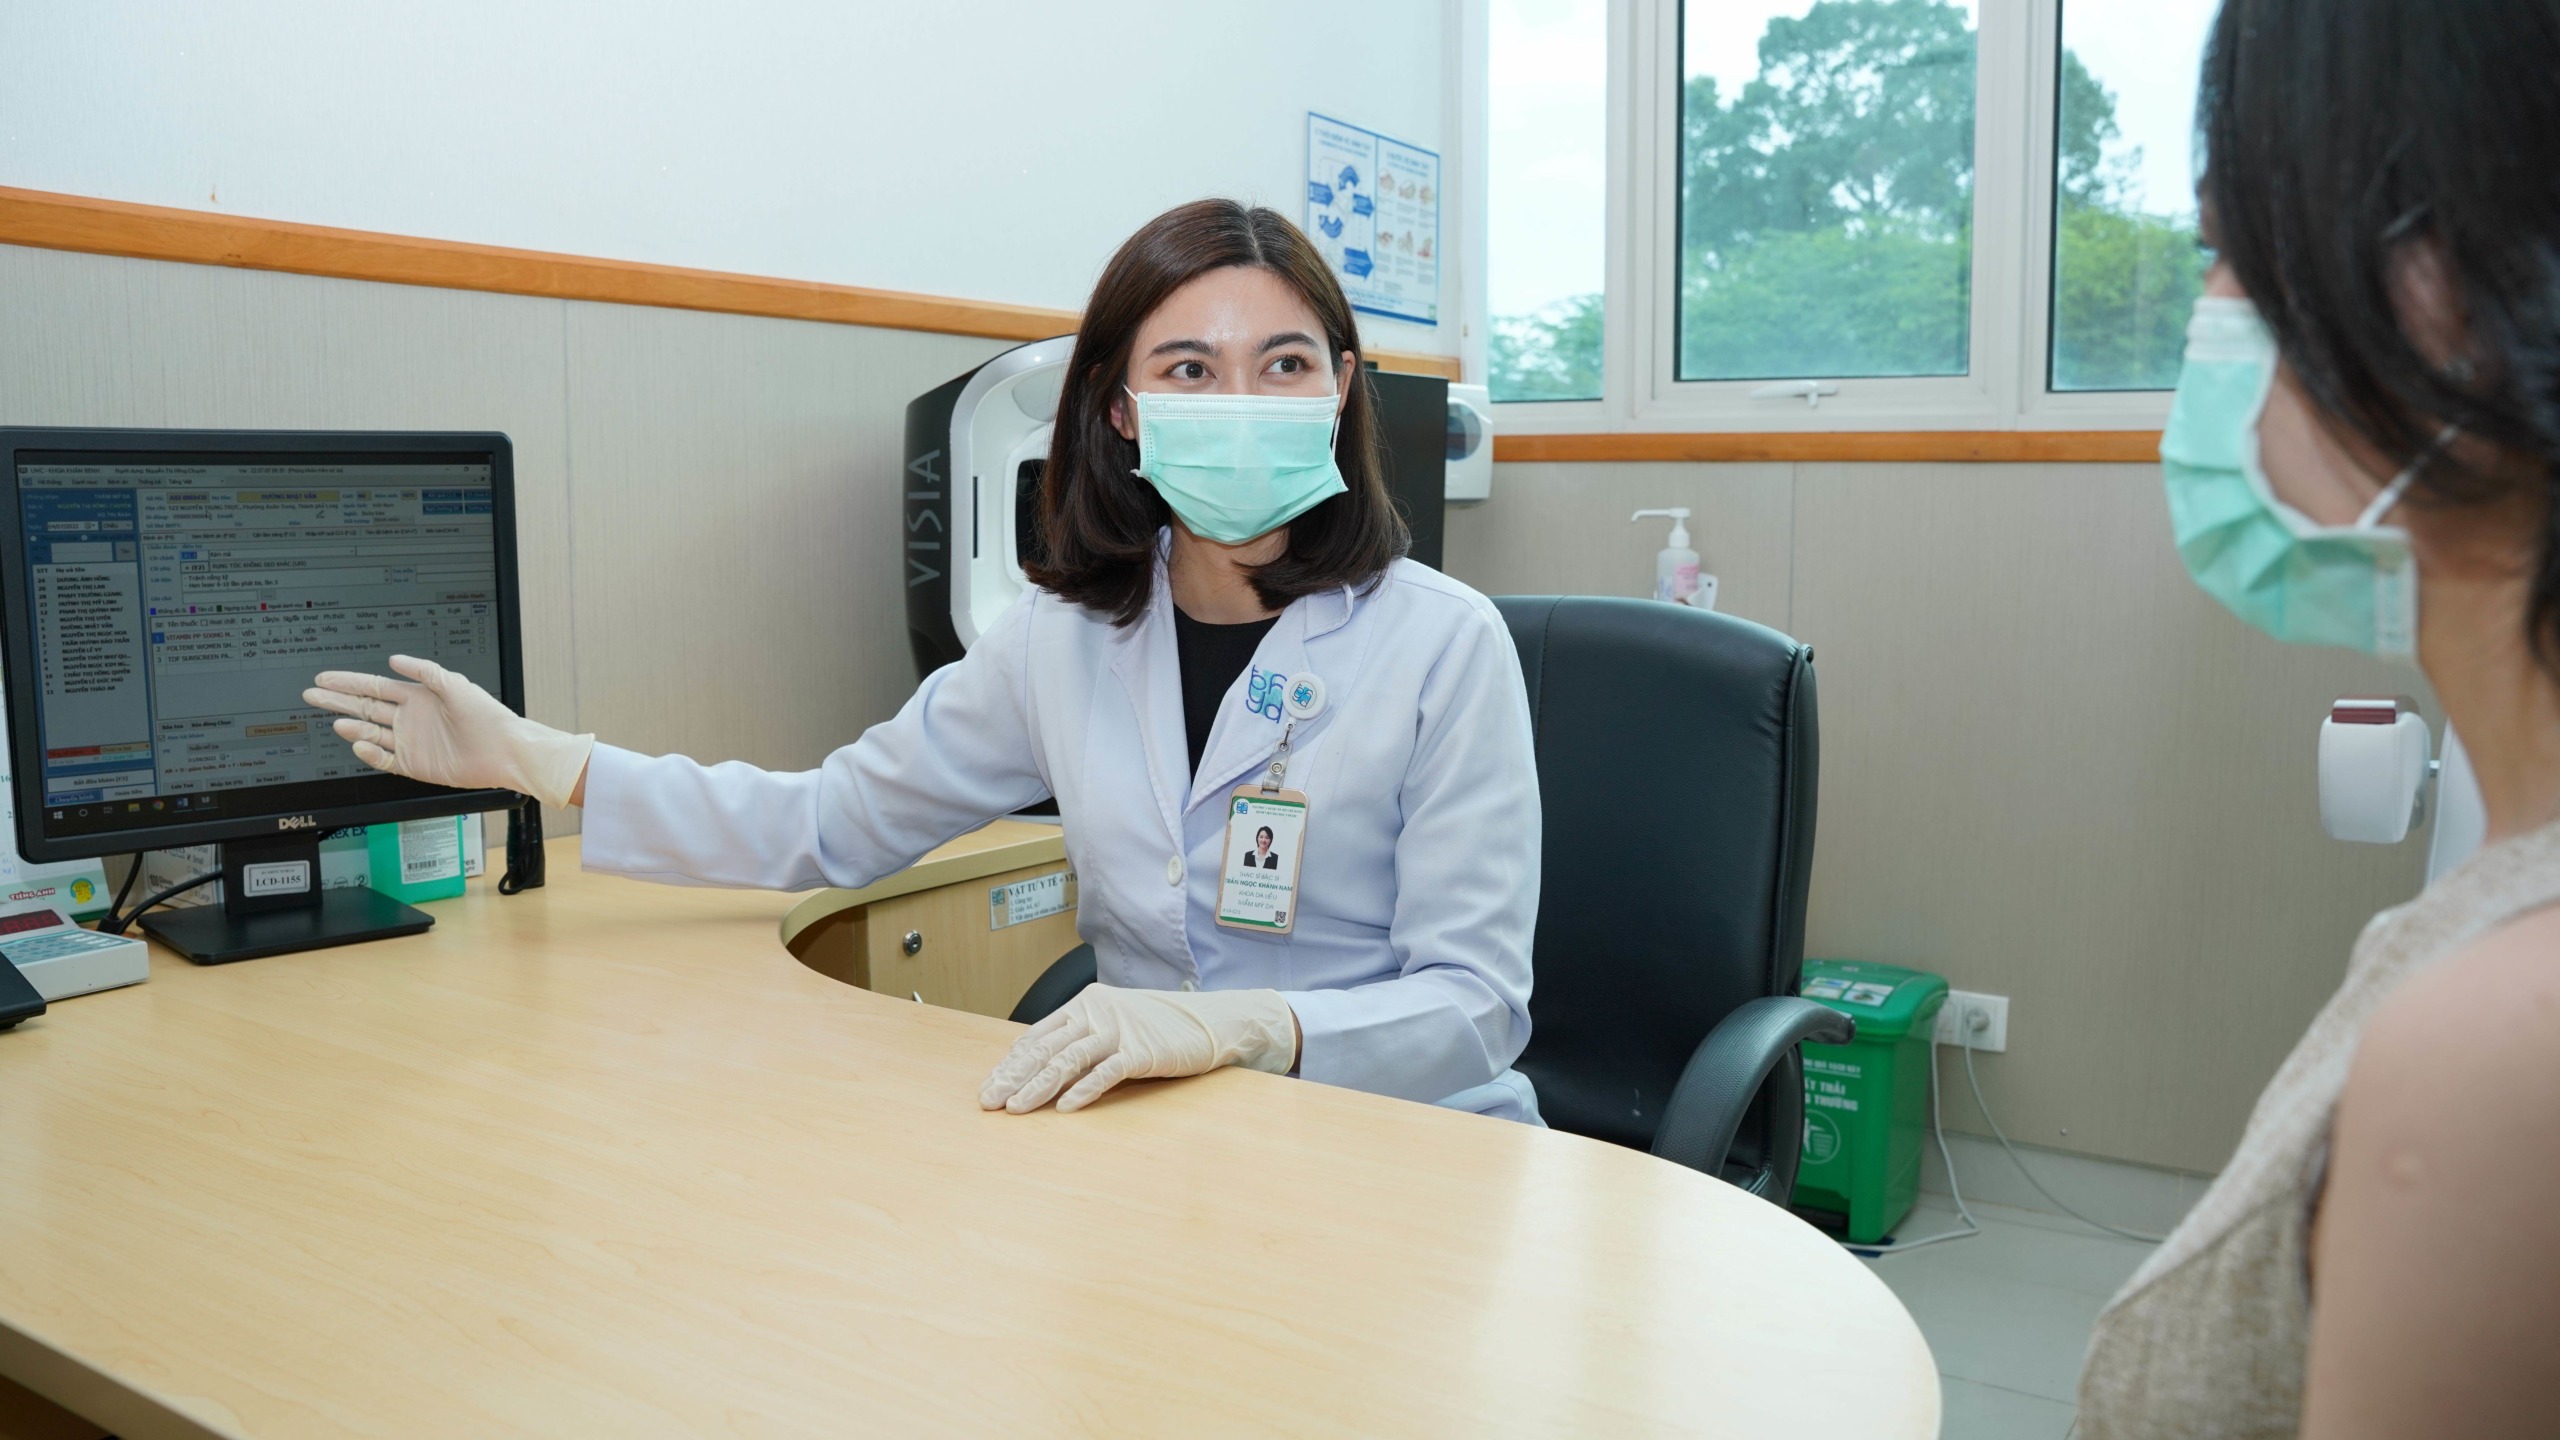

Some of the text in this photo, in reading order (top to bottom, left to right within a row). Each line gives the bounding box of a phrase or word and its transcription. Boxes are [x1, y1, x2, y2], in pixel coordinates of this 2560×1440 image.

[907, 448, 944, 588] VISIA
[278, 815, 318, 831] DELL
[256, 875, 302, 888] LCD-1155
[1009, 885, 1025, 898] VẬT
[1027, 881, 1040, 893] TƯ
[1039, 879, 1047, 889] Y
[1048, 874, 1059, 888] TẾ
[1239, 879, 1258, 888] NGỌC
[9, 887, 56, 901] TIẾNG ANH
[1820, 1080, 1846, 1096] THẢI
[1814, 1094, 1859, 1112] THƯỜNG
